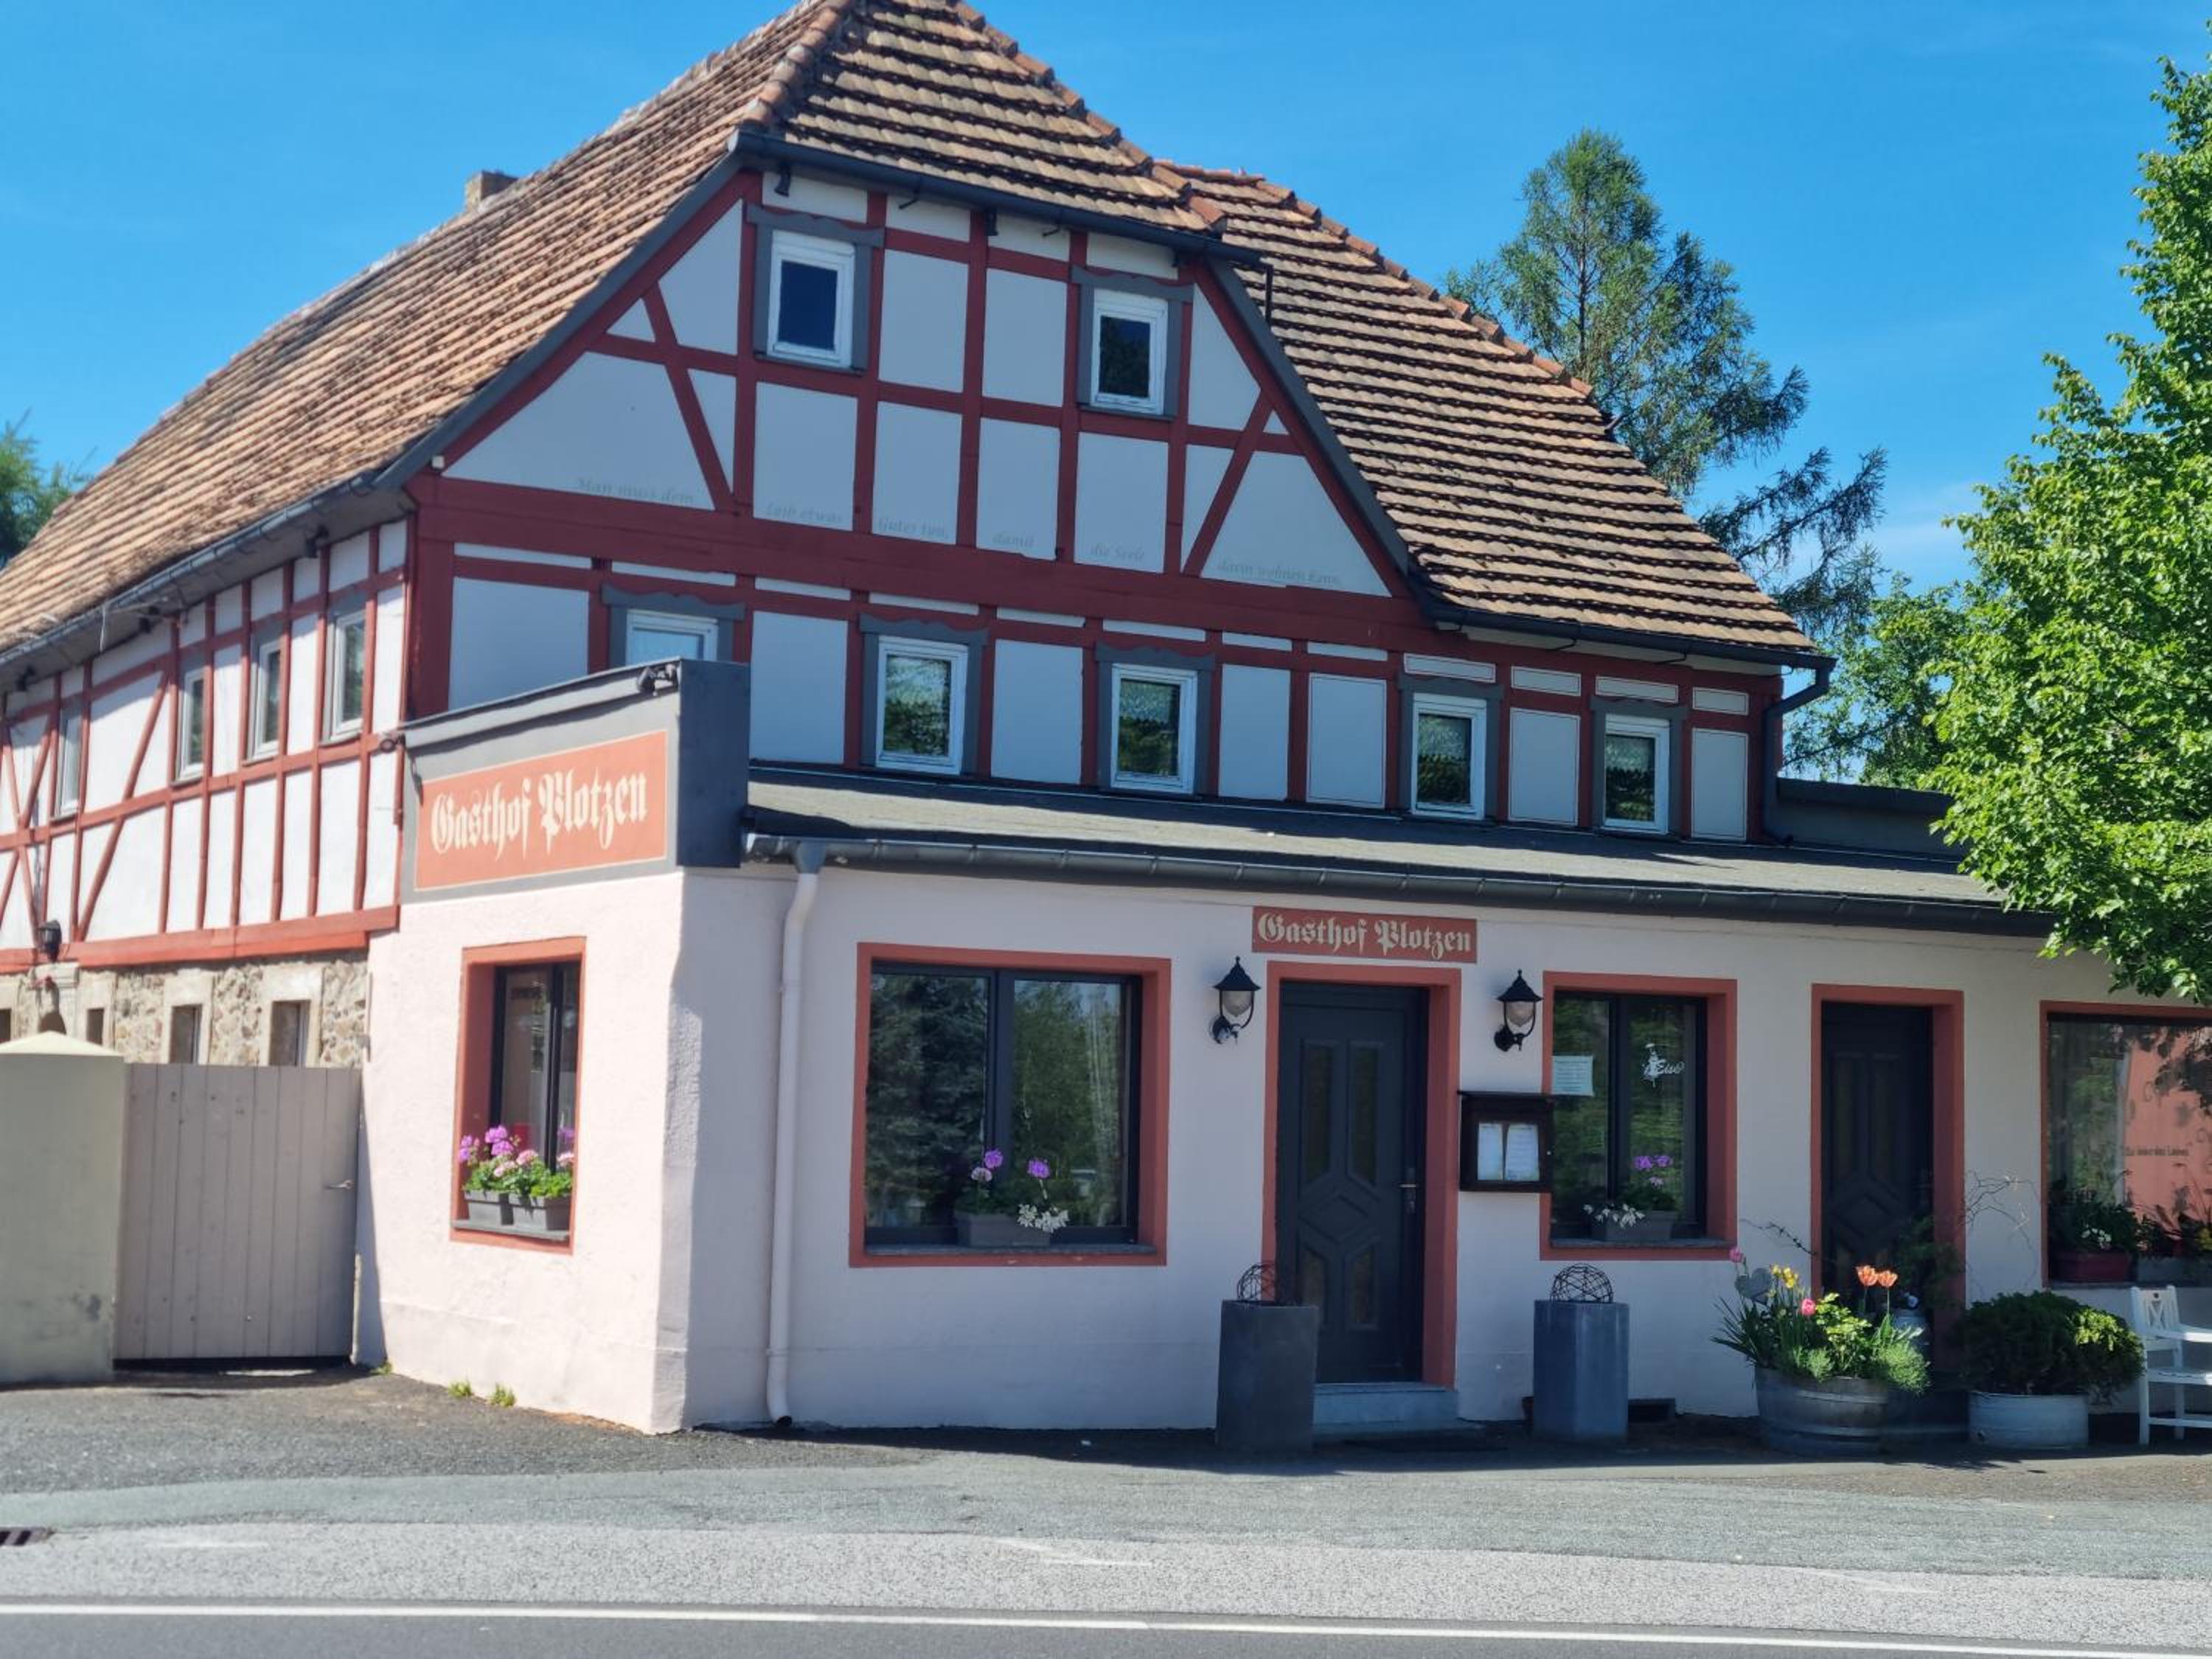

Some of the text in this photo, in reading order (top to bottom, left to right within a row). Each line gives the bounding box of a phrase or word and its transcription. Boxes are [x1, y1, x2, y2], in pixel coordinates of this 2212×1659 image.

[431, 766, 647, 861] Gasthof Plotzen
[1257, 912, 1471, 959] Gasthof Plotzen
